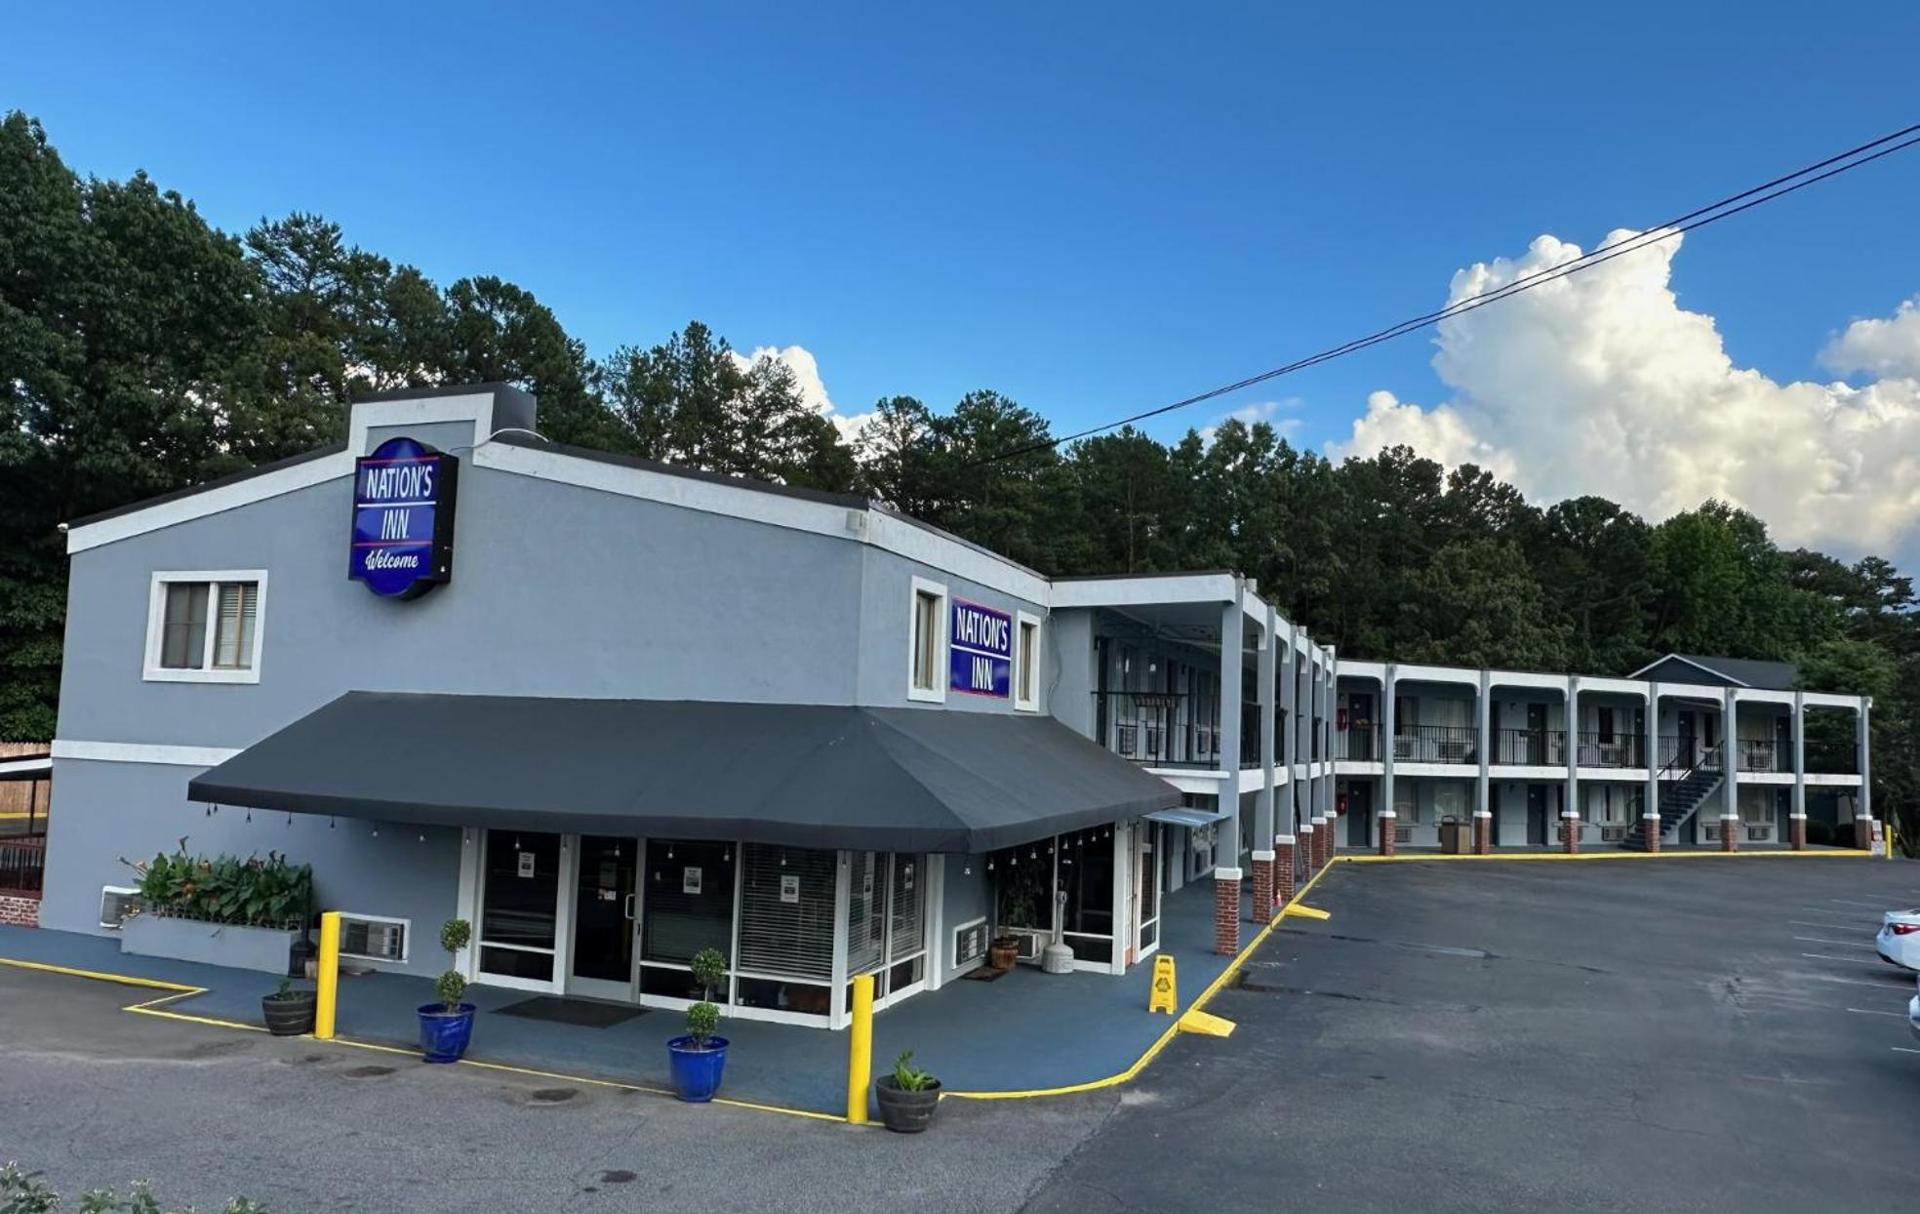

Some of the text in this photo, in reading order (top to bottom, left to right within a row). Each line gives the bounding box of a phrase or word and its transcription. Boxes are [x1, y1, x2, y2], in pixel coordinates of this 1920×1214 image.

[367, 465, 433, 499] NATION'S
[381, 509, 410, 540] INN
[365, 549, 419, 570] Welcome
[956, 607, 1008, 651] NATION'S
[972, 656, 993, 690] INN
